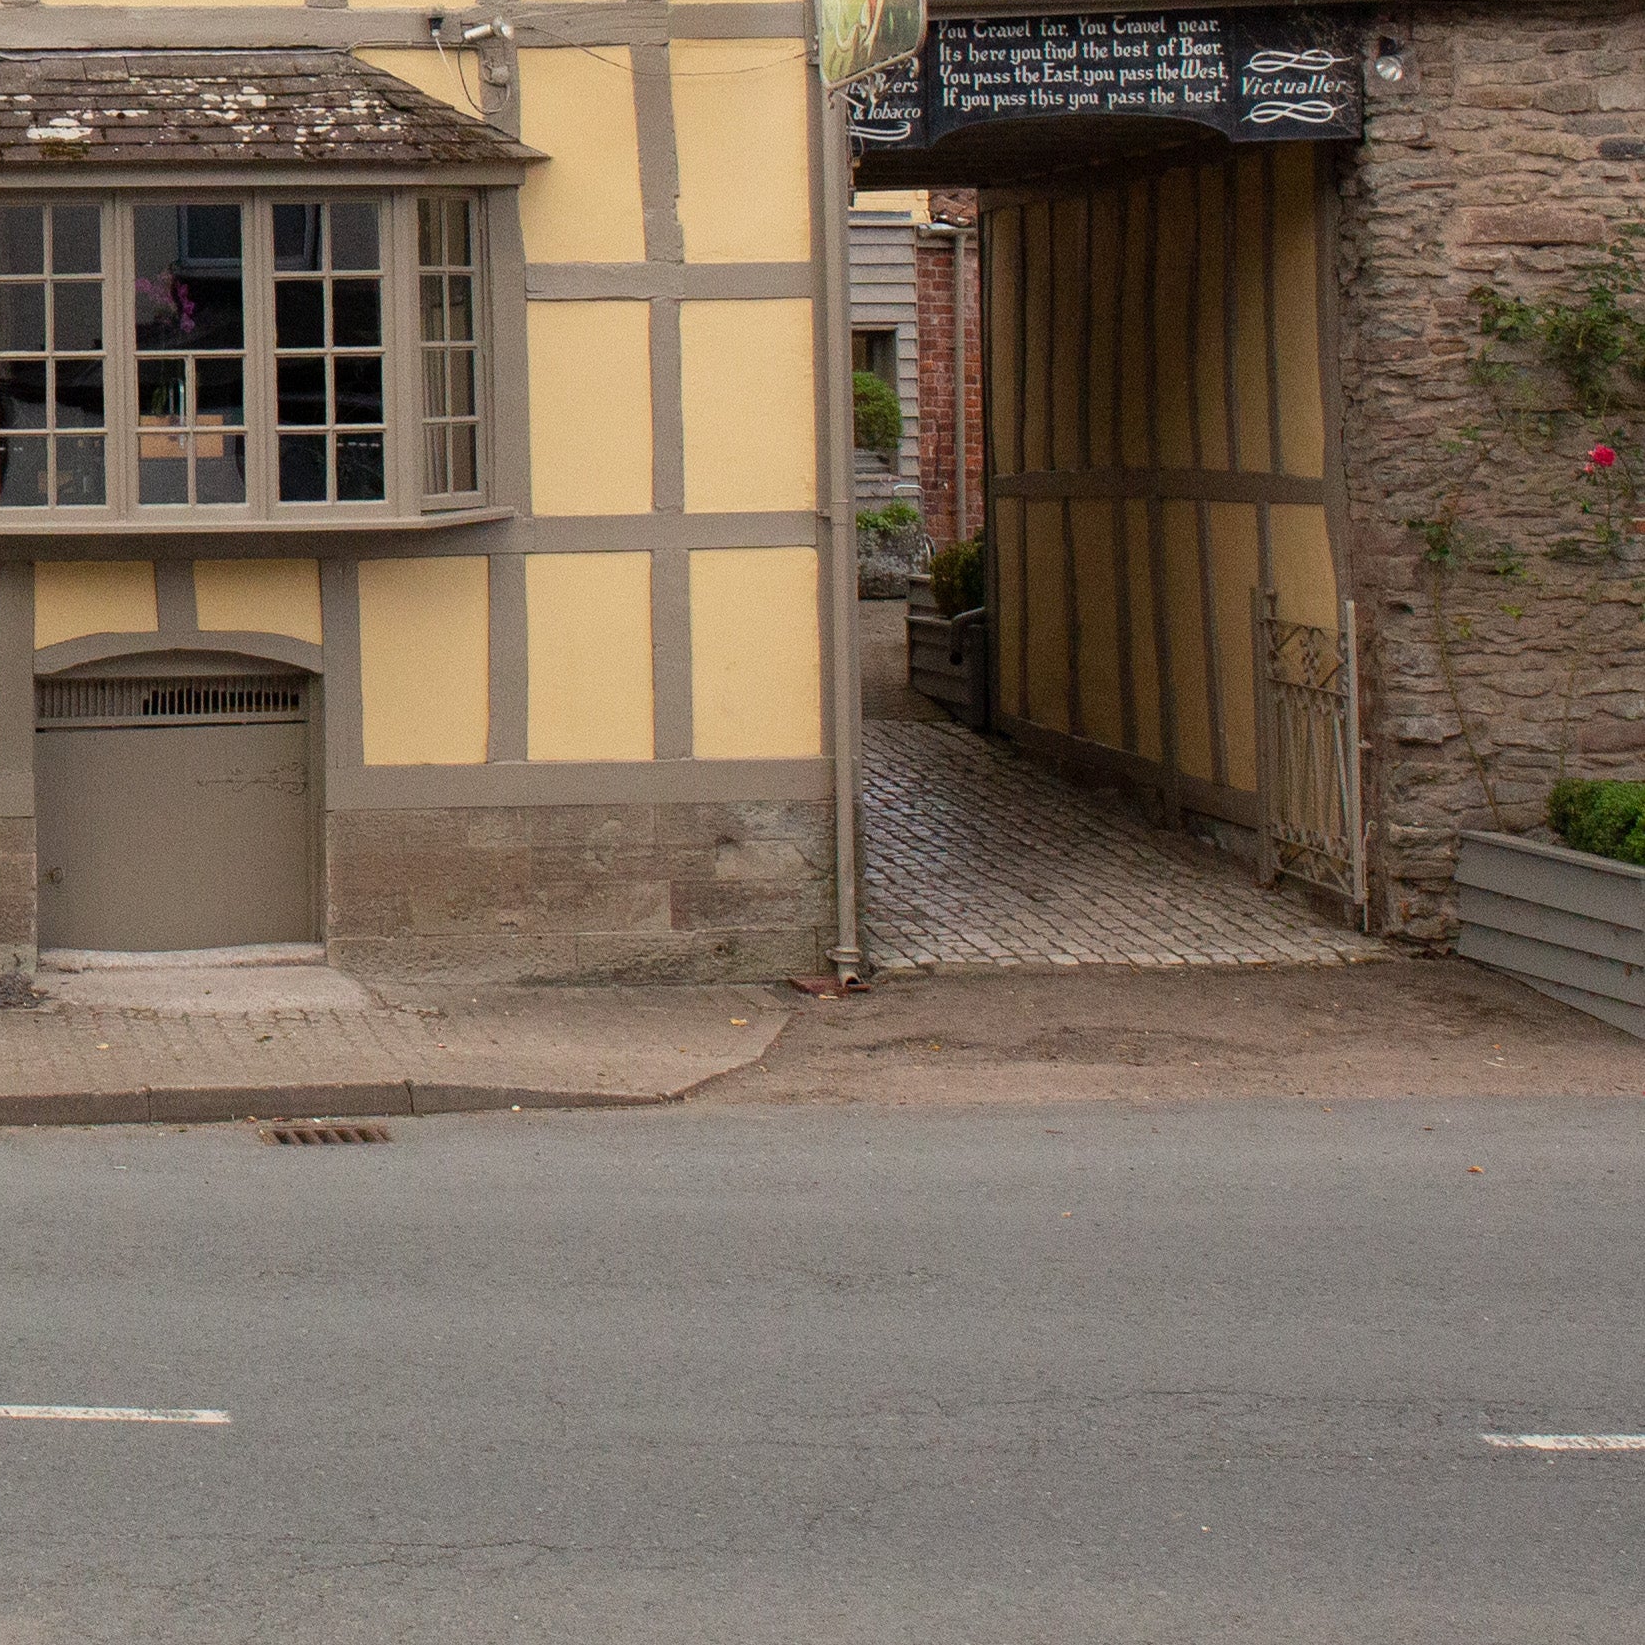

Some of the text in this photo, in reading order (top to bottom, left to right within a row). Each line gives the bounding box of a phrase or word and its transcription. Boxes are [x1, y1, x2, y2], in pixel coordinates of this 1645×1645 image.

[938, 19, 968, 40] You
[972, 18, 1031, 38] Travel
[1077, 16, 1109, 36] You
[1112, 15, 1167, 35] Travel
[939, 42, 963, 63] Its
[968, 42, 1007, 65] here
[1010, 47, 1043, 65] you
[1044, 40, 1078, 61] find
[1082, 41, 1109, 61] the
[1113, 39, 1150, 58] best
[1157, 37, 1178, 57] of
[939, 64, 971, 86] You
[973, 72, 1012, 92] pass
[1013, 65, 1041, 85] the
[1083, 68, 1115, 87] you
[1118, 67, 1154, 88] pass
[1155, 61, 1180, 82] the
[1240, 74, 1356, 96] Victuallers
[942, 87, 959, 108] If
[960, 94, 992, 113] you
[993, 94, 1028, 113] pass
[1029, 88, 1065, 109] this
[1067, 92, 1100, 112] you
[1107, 91, 1146, 111] pass
[1150, 86, 1176, 107] the
